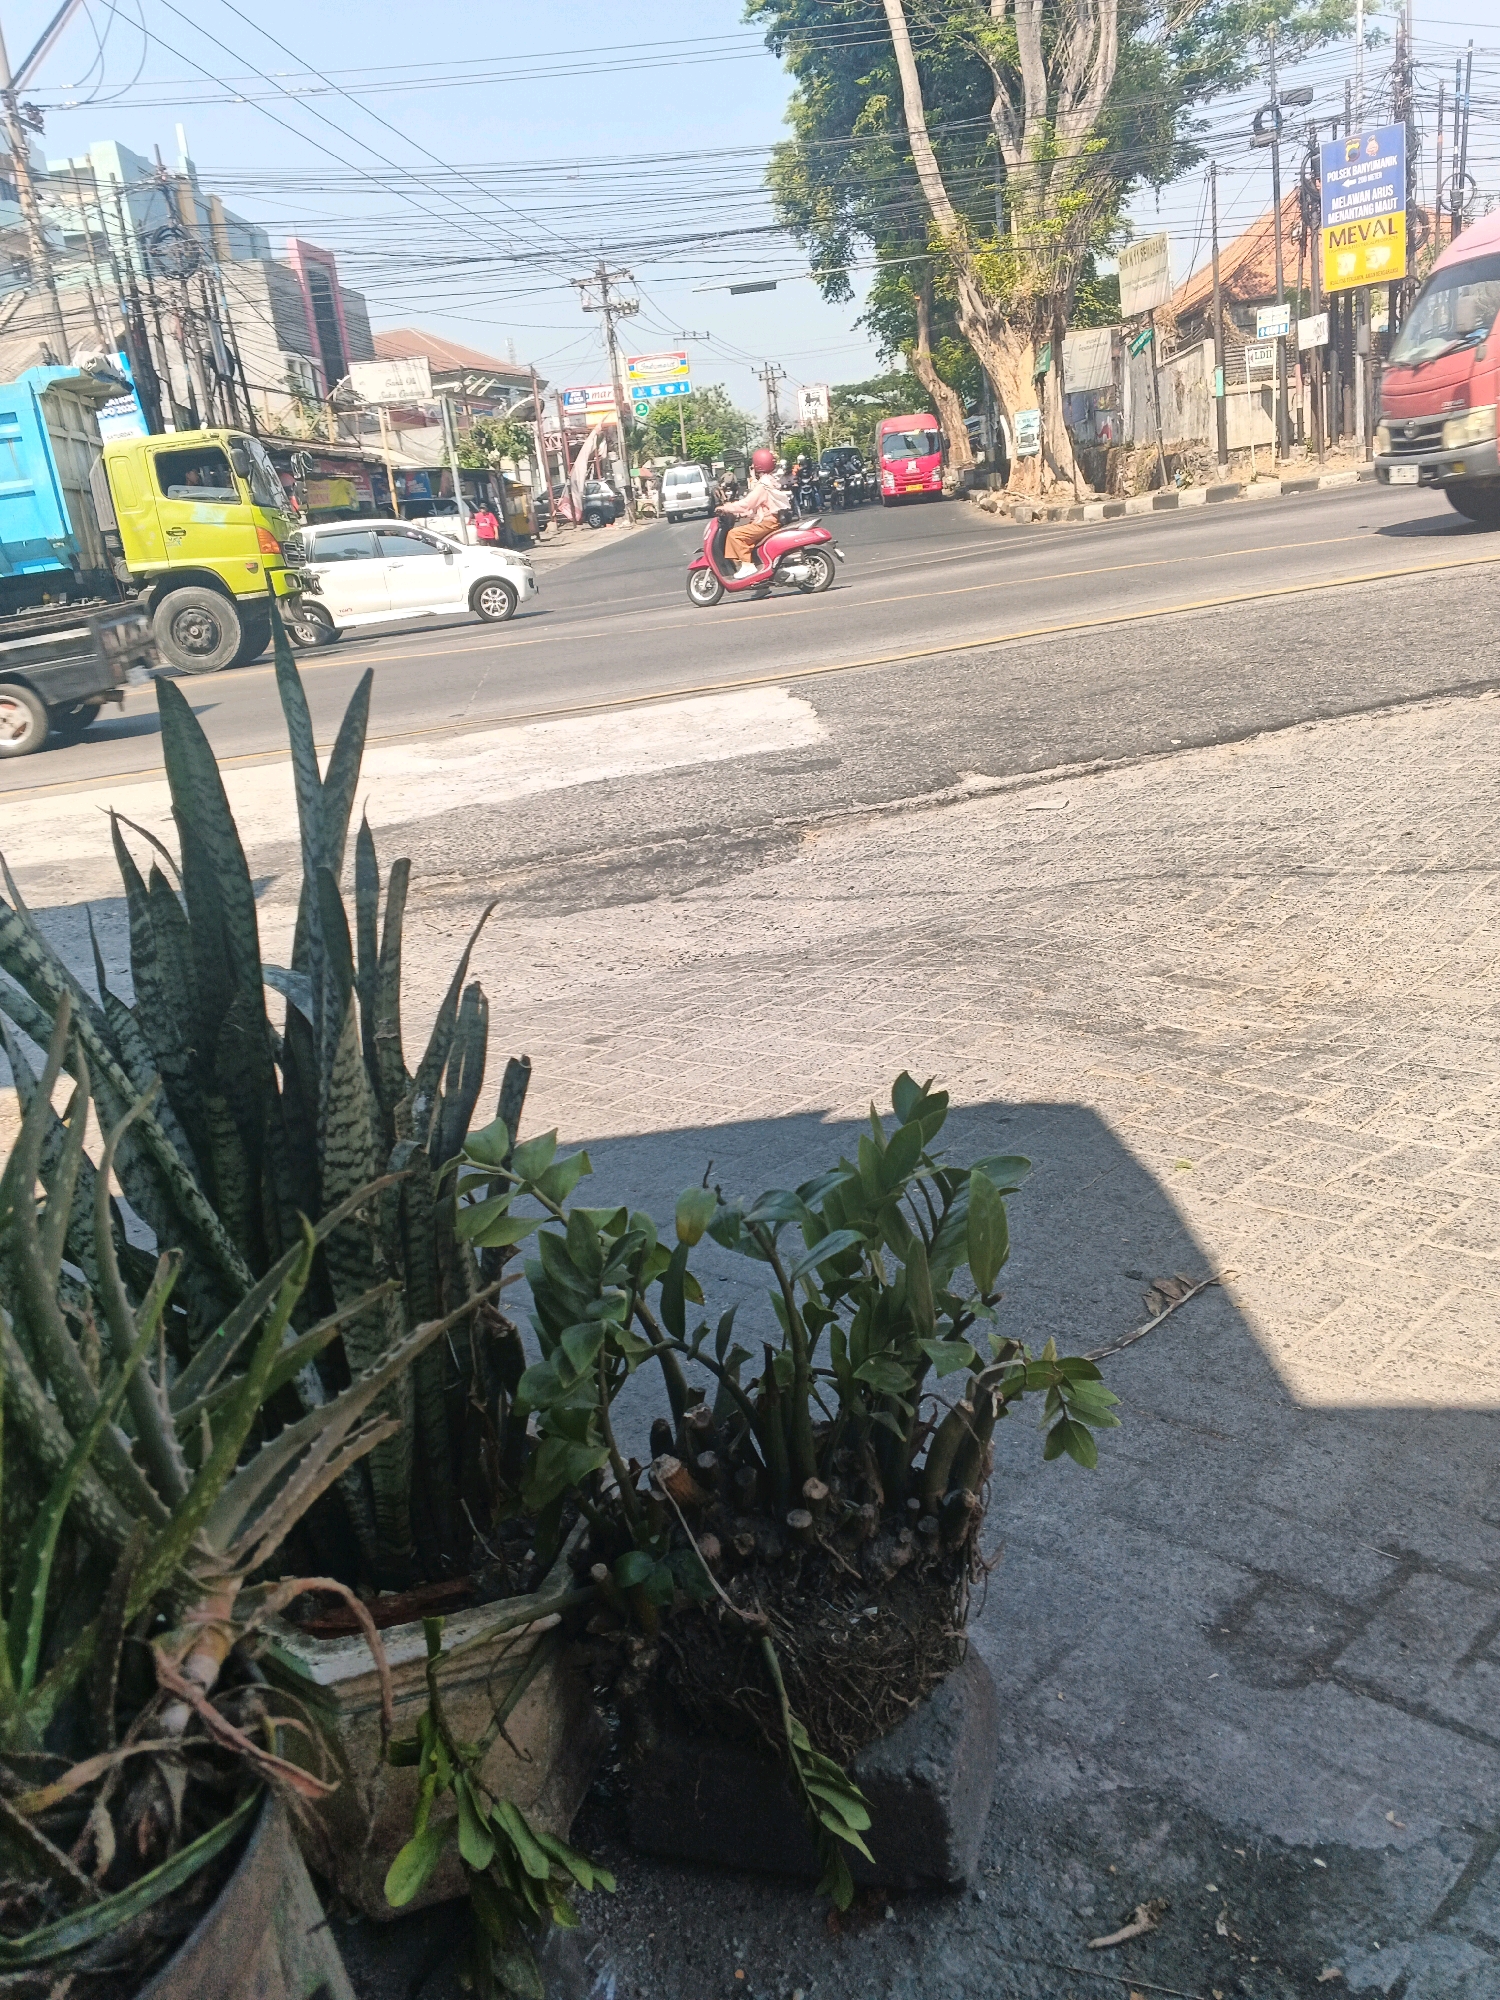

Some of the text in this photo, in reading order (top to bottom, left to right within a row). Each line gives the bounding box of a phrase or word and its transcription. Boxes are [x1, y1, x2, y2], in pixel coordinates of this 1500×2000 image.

[1327, 155, 1398, 183] POLSEK BANYUMANIK
[1368, 171, 1382, 182] METER
[1328, 197, 1398, 225] MENANTANG MAUT
[1332, 184, 1394, 211] MELAWAN ARUS
[1329, 217, 1398, 249] MEVAL
[1140, 237, 1167, 262] SEMARANG
[1255, 349, 1272, 360] LDII
